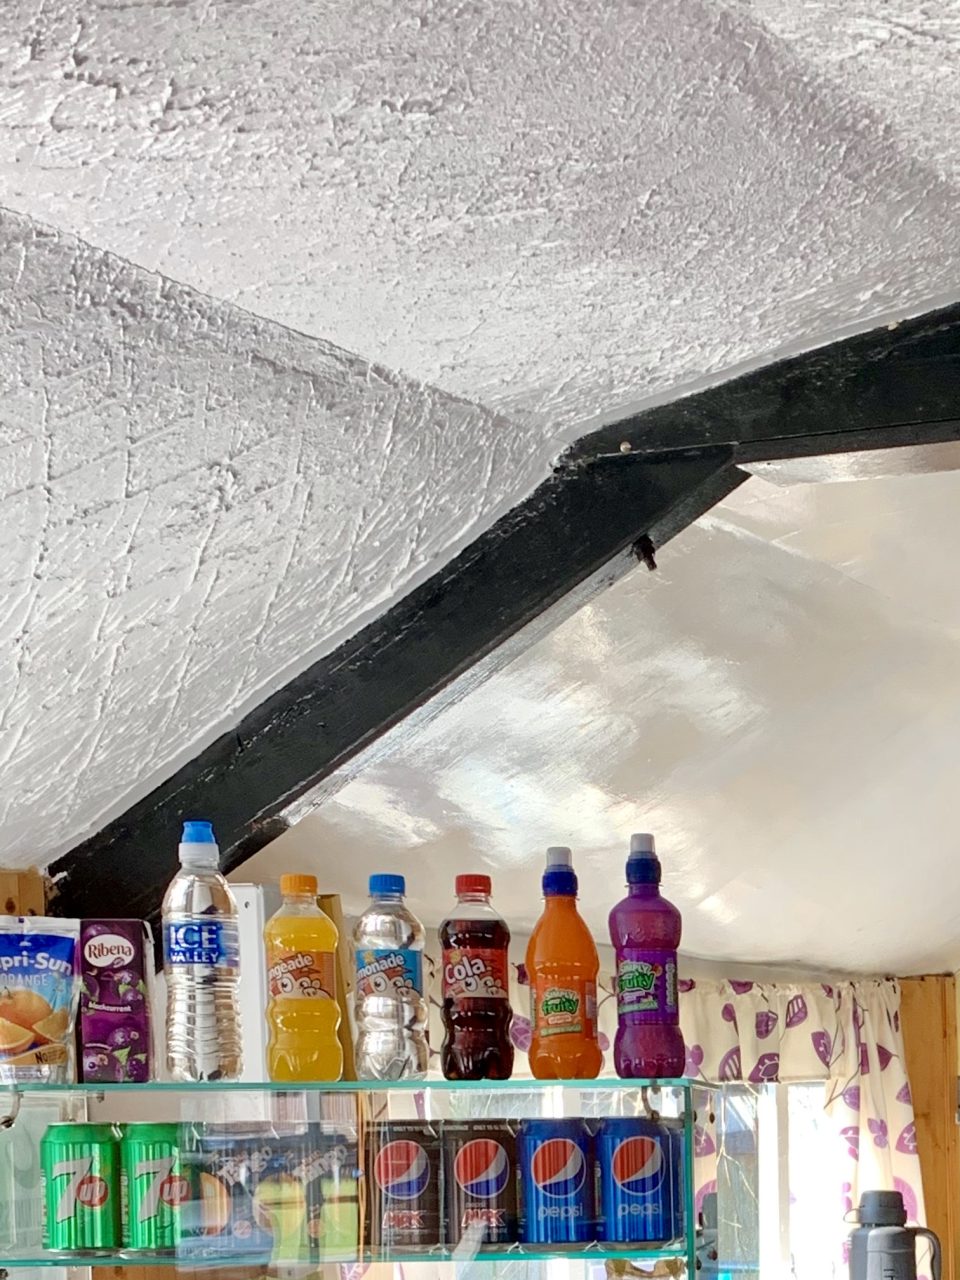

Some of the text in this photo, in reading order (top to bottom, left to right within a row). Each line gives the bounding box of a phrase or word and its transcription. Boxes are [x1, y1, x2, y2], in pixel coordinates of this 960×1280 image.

[169, 925, 217, 949] ICE
[87, 943, 132, 959] Ribena
[169, 951, 219, 963] VALLEY
[0, 950, 72, 976] pri-Sun
[445, 956, 487, 983] Cola
[0, 973, 49, 986] ORANGE
[542, 996, 579, 1016] fruity
[537, 1204, 583, 1221] pepsi
[617, 1201, 663, 1217] pepsi
